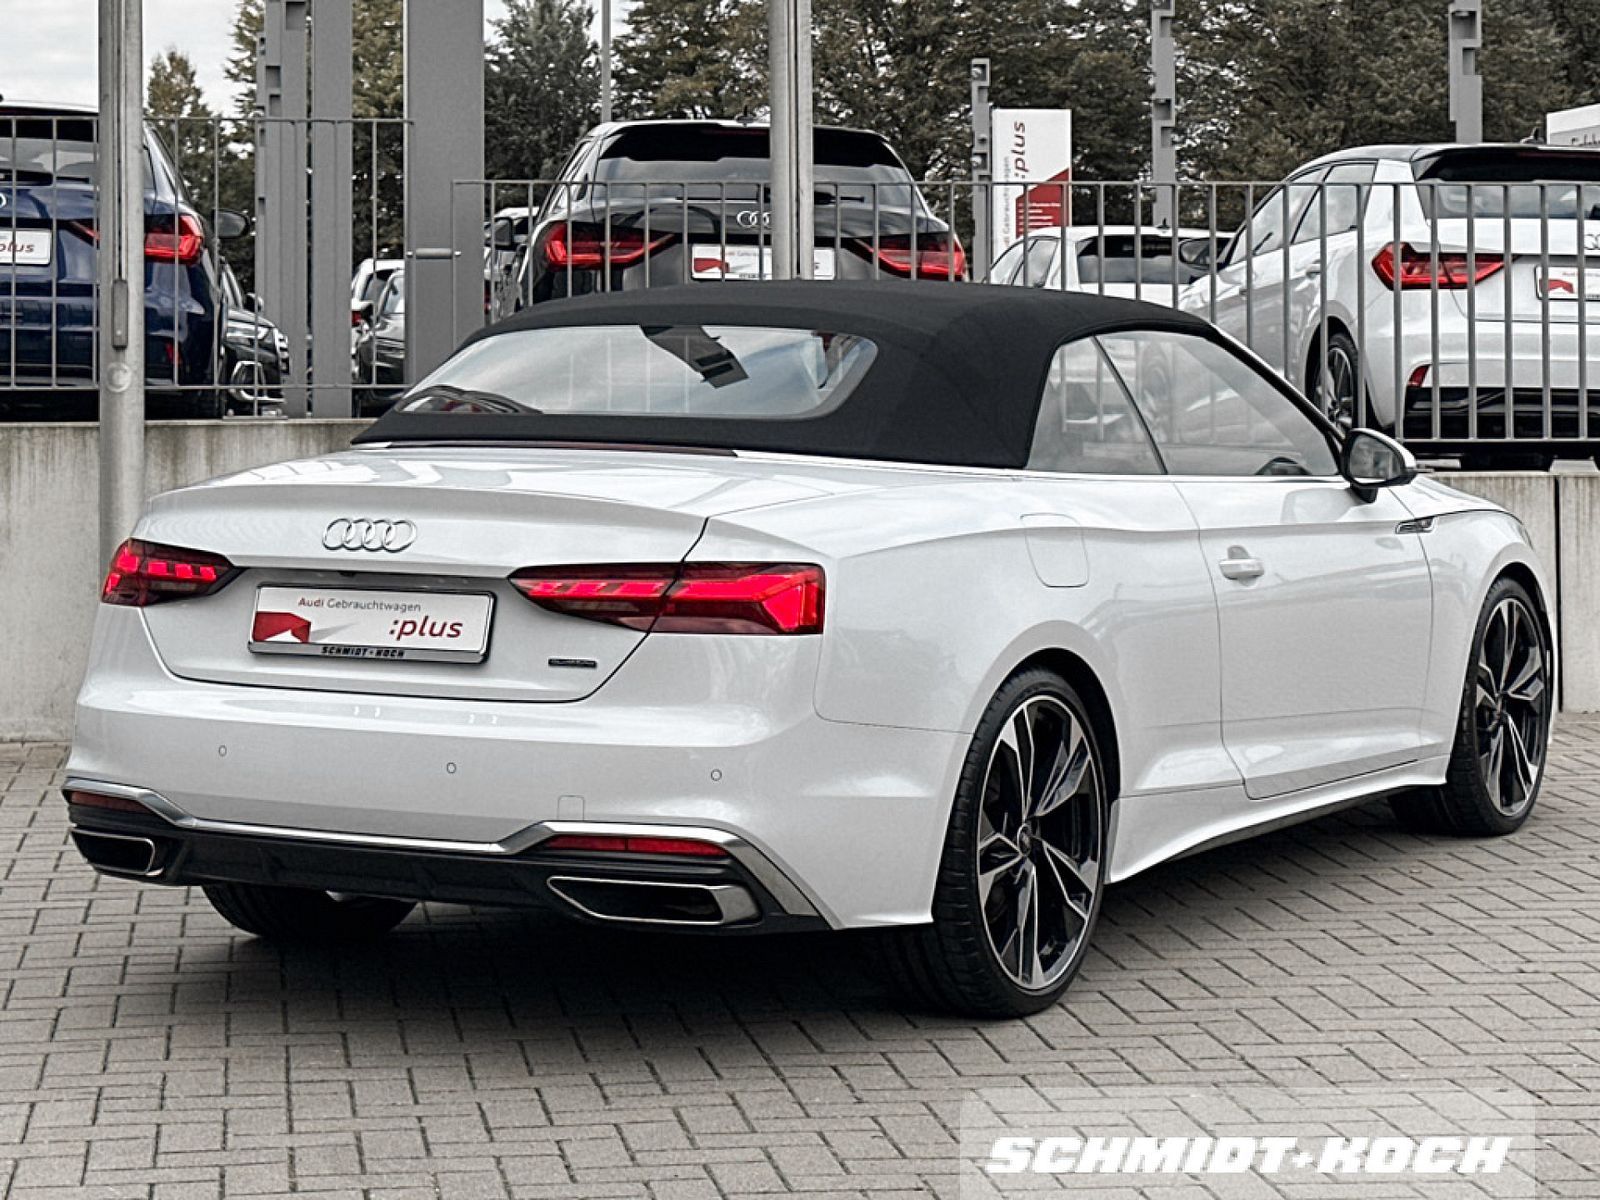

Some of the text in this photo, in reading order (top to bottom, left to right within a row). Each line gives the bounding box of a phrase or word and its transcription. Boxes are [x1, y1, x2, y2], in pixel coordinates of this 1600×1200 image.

[1011, 121, 1028, 179] :plus
[298, 597, 422, 614] Audi Gebrauchtwagen
[389, 615, 463, 641] :plus
